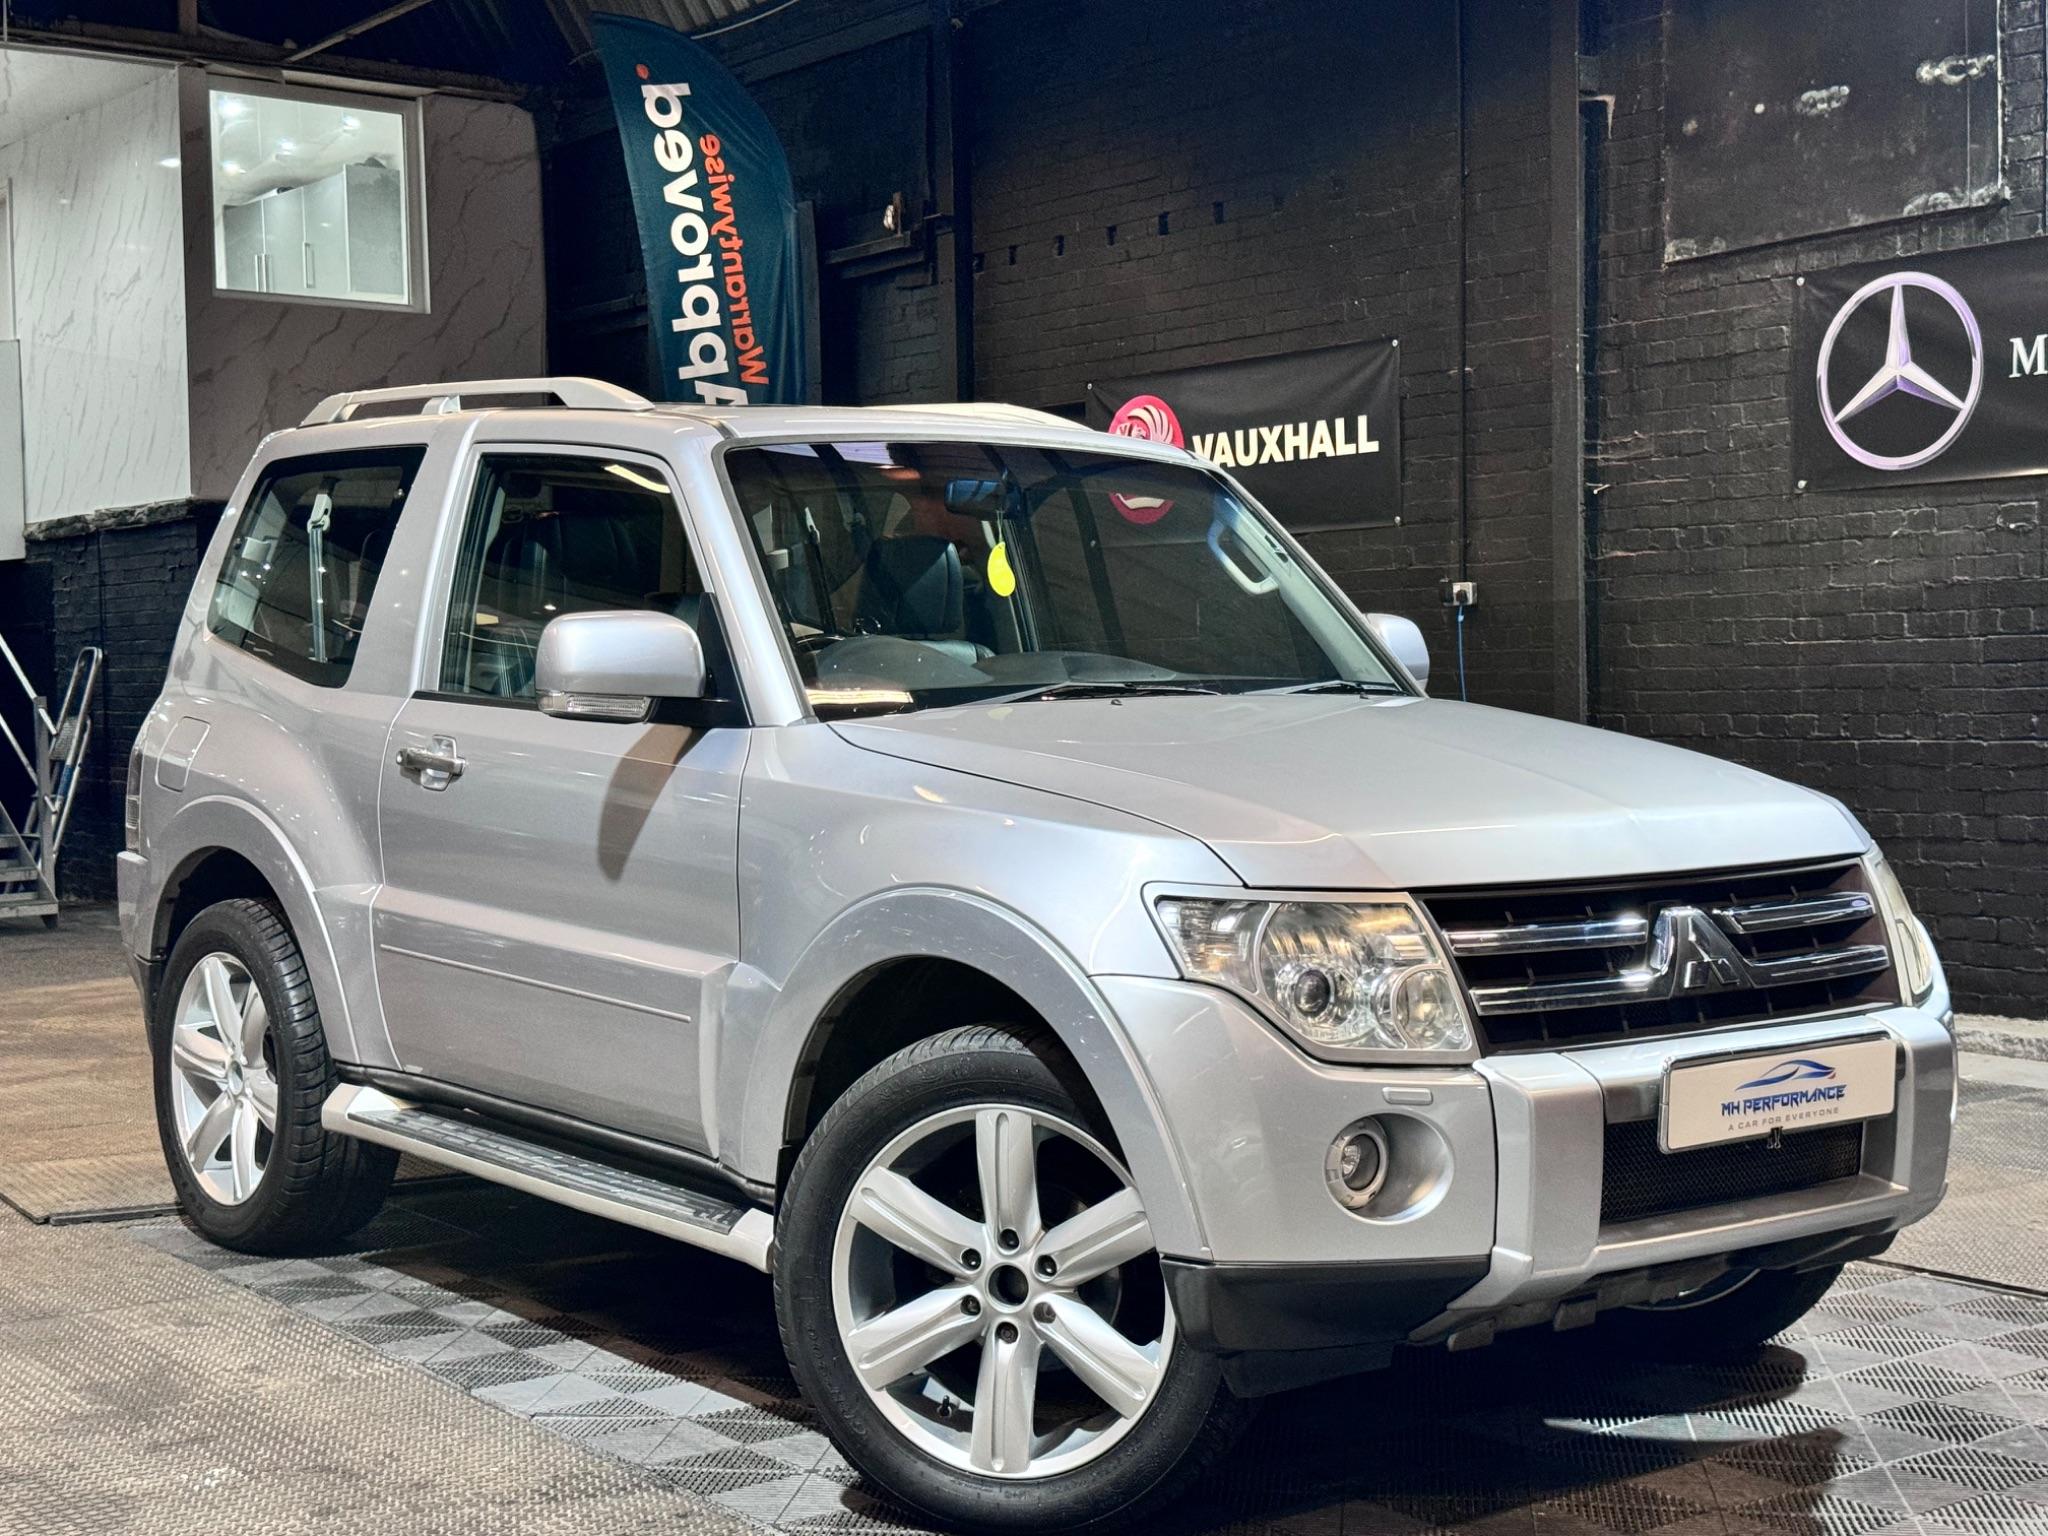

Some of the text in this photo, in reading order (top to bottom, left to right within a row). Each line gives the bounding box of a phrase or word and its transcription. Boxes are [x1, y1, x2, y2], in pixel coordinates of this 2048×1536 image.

[1192, 414, 1380, 469] VAUXHALL
[1721, 1084, 1847, 1116] MH PERFORMANCE
[1728, 1106, 1839, 1131] A CAR FOR EVERYONE
